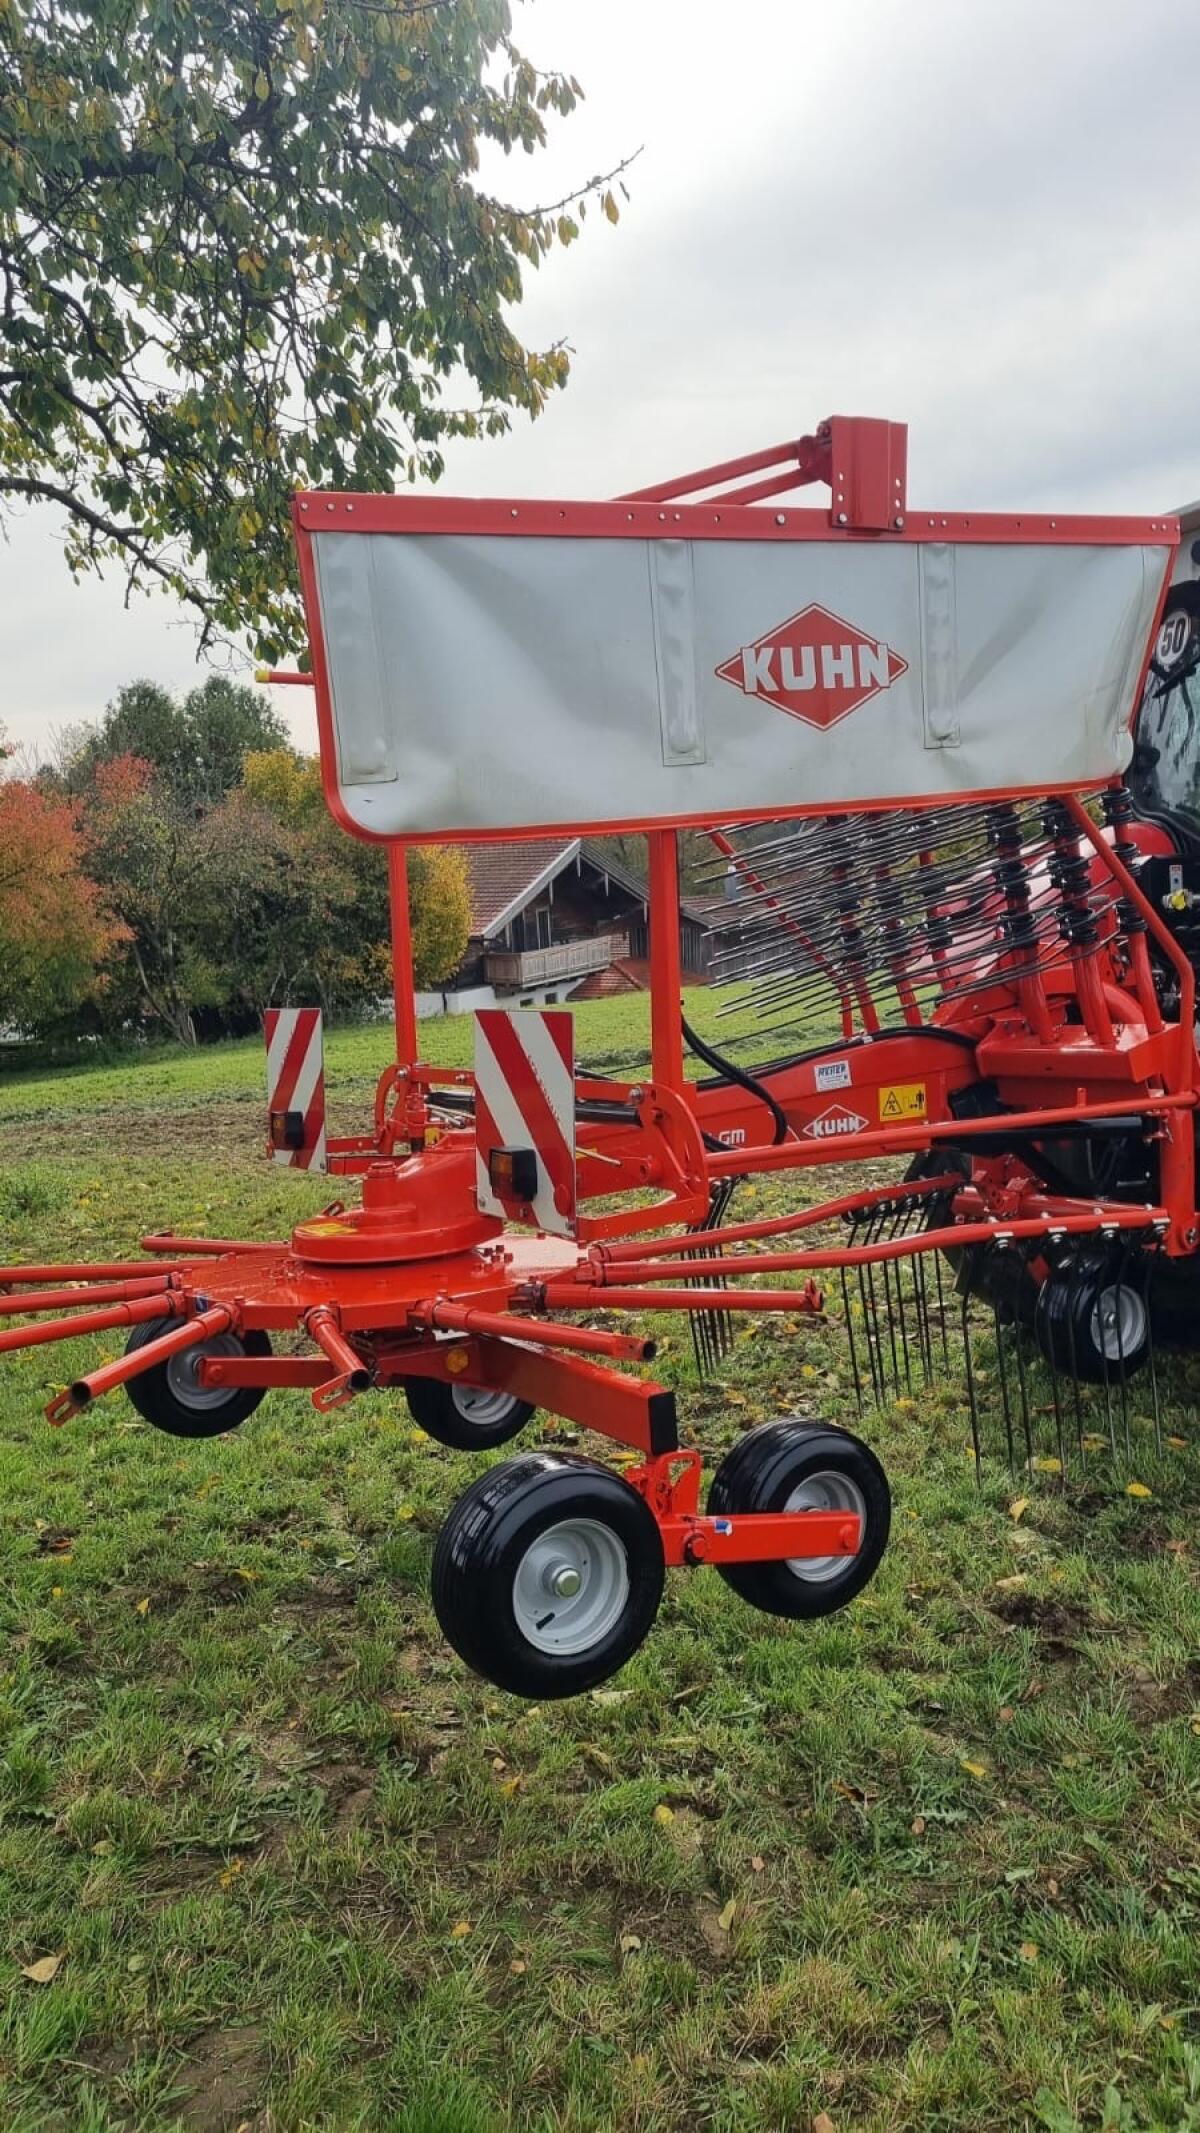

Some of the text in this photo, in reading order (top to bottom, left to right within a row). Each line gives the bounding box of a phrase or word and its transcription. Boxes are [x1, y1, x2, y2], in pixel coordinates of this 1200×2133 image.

[1161, 618, 1186, 657] 50
[742, 644, 890, 693] KUHN
[813, 1116, 859, 1137] KUHN
